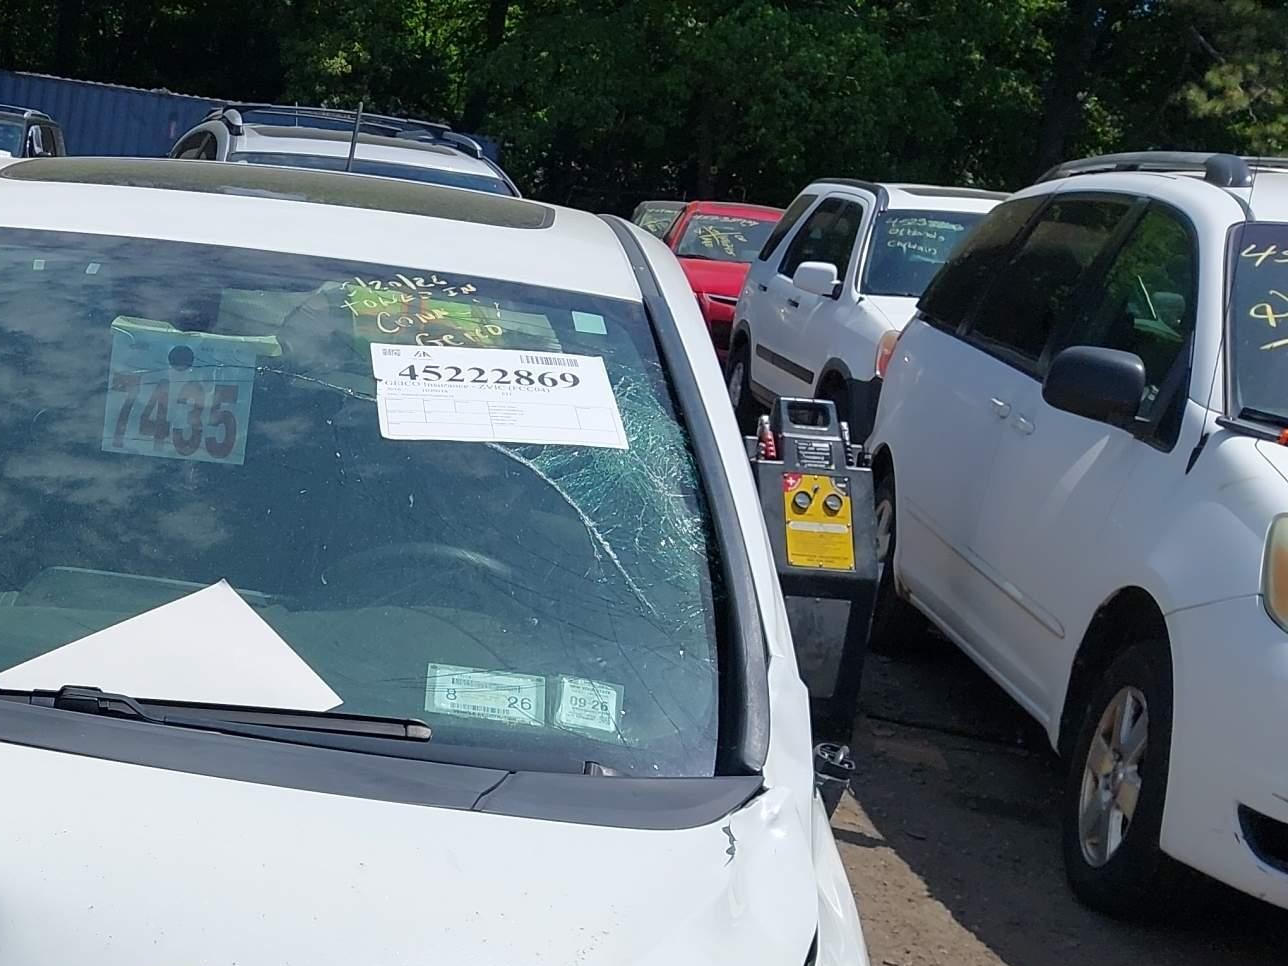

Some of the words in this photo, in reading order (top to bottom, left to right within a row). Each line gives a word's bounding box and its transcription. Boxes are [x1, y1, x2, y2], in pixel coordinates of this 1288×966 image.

[398, 364, 581, 388] 45222869
[112, 373, 238, 459] 7435
[446, 687, 457, 701] 8
[508, 695, 532, 711] 26
[591, 699, 608, 711] 26
